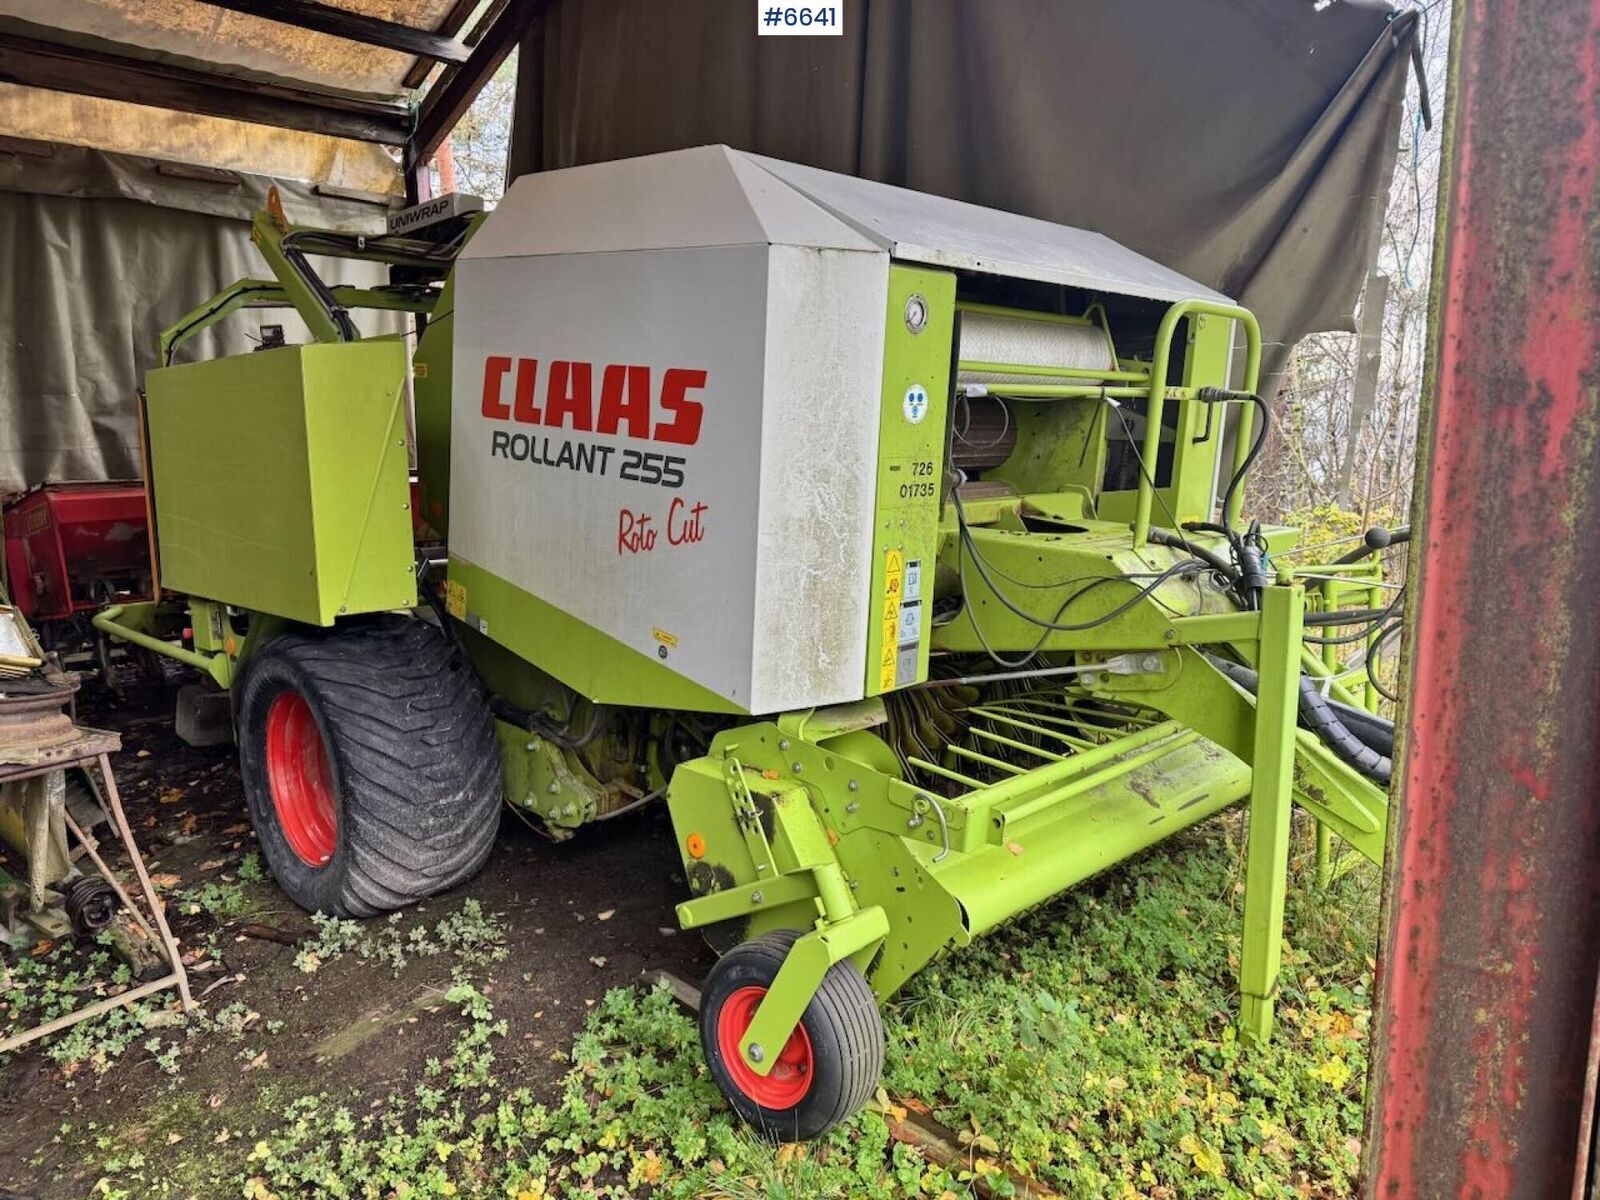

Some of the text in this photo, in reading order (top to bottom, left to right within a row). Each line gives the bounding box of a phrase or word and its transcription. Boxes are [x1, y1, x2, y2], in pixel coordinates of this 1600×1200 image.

[390, 200, 448, 230] UNIWRAP
[481, 355, 708, 446] CLAAS
[491, 430, 686, 489] ROLLANT 255
[912, 461, 933, 476] 726
[900, 482, 935, 498] 01735
[618, 497, 708, 555] Roto Cut
